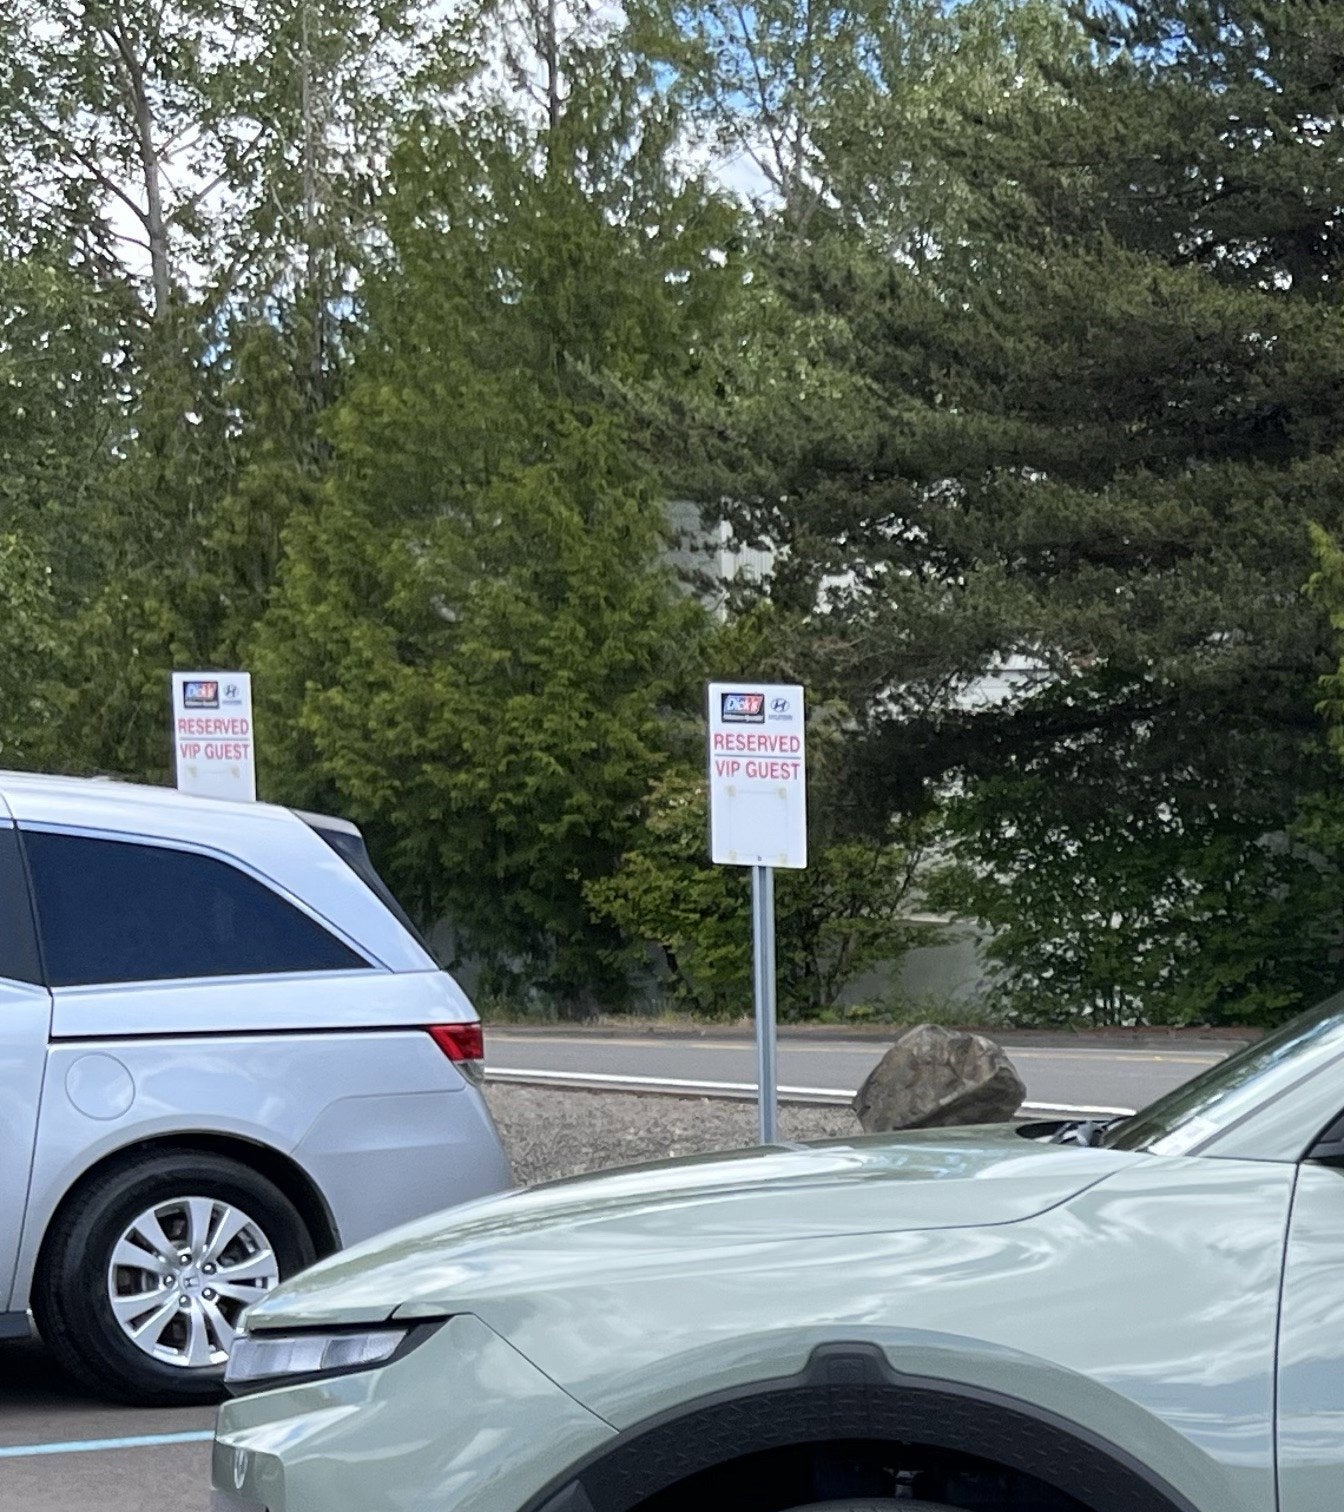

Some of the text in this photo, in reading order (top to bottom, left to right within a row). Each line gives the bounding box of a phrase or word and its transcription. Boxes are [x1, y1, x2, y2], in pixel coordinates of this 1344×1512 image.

[178, 717, 249, 736] RESERVED
[180, 742, 250, 760] VIP GUEST
[713, 732, 801, 753] RESERVED
[715, 760, 801, 780] VIP GUEST
